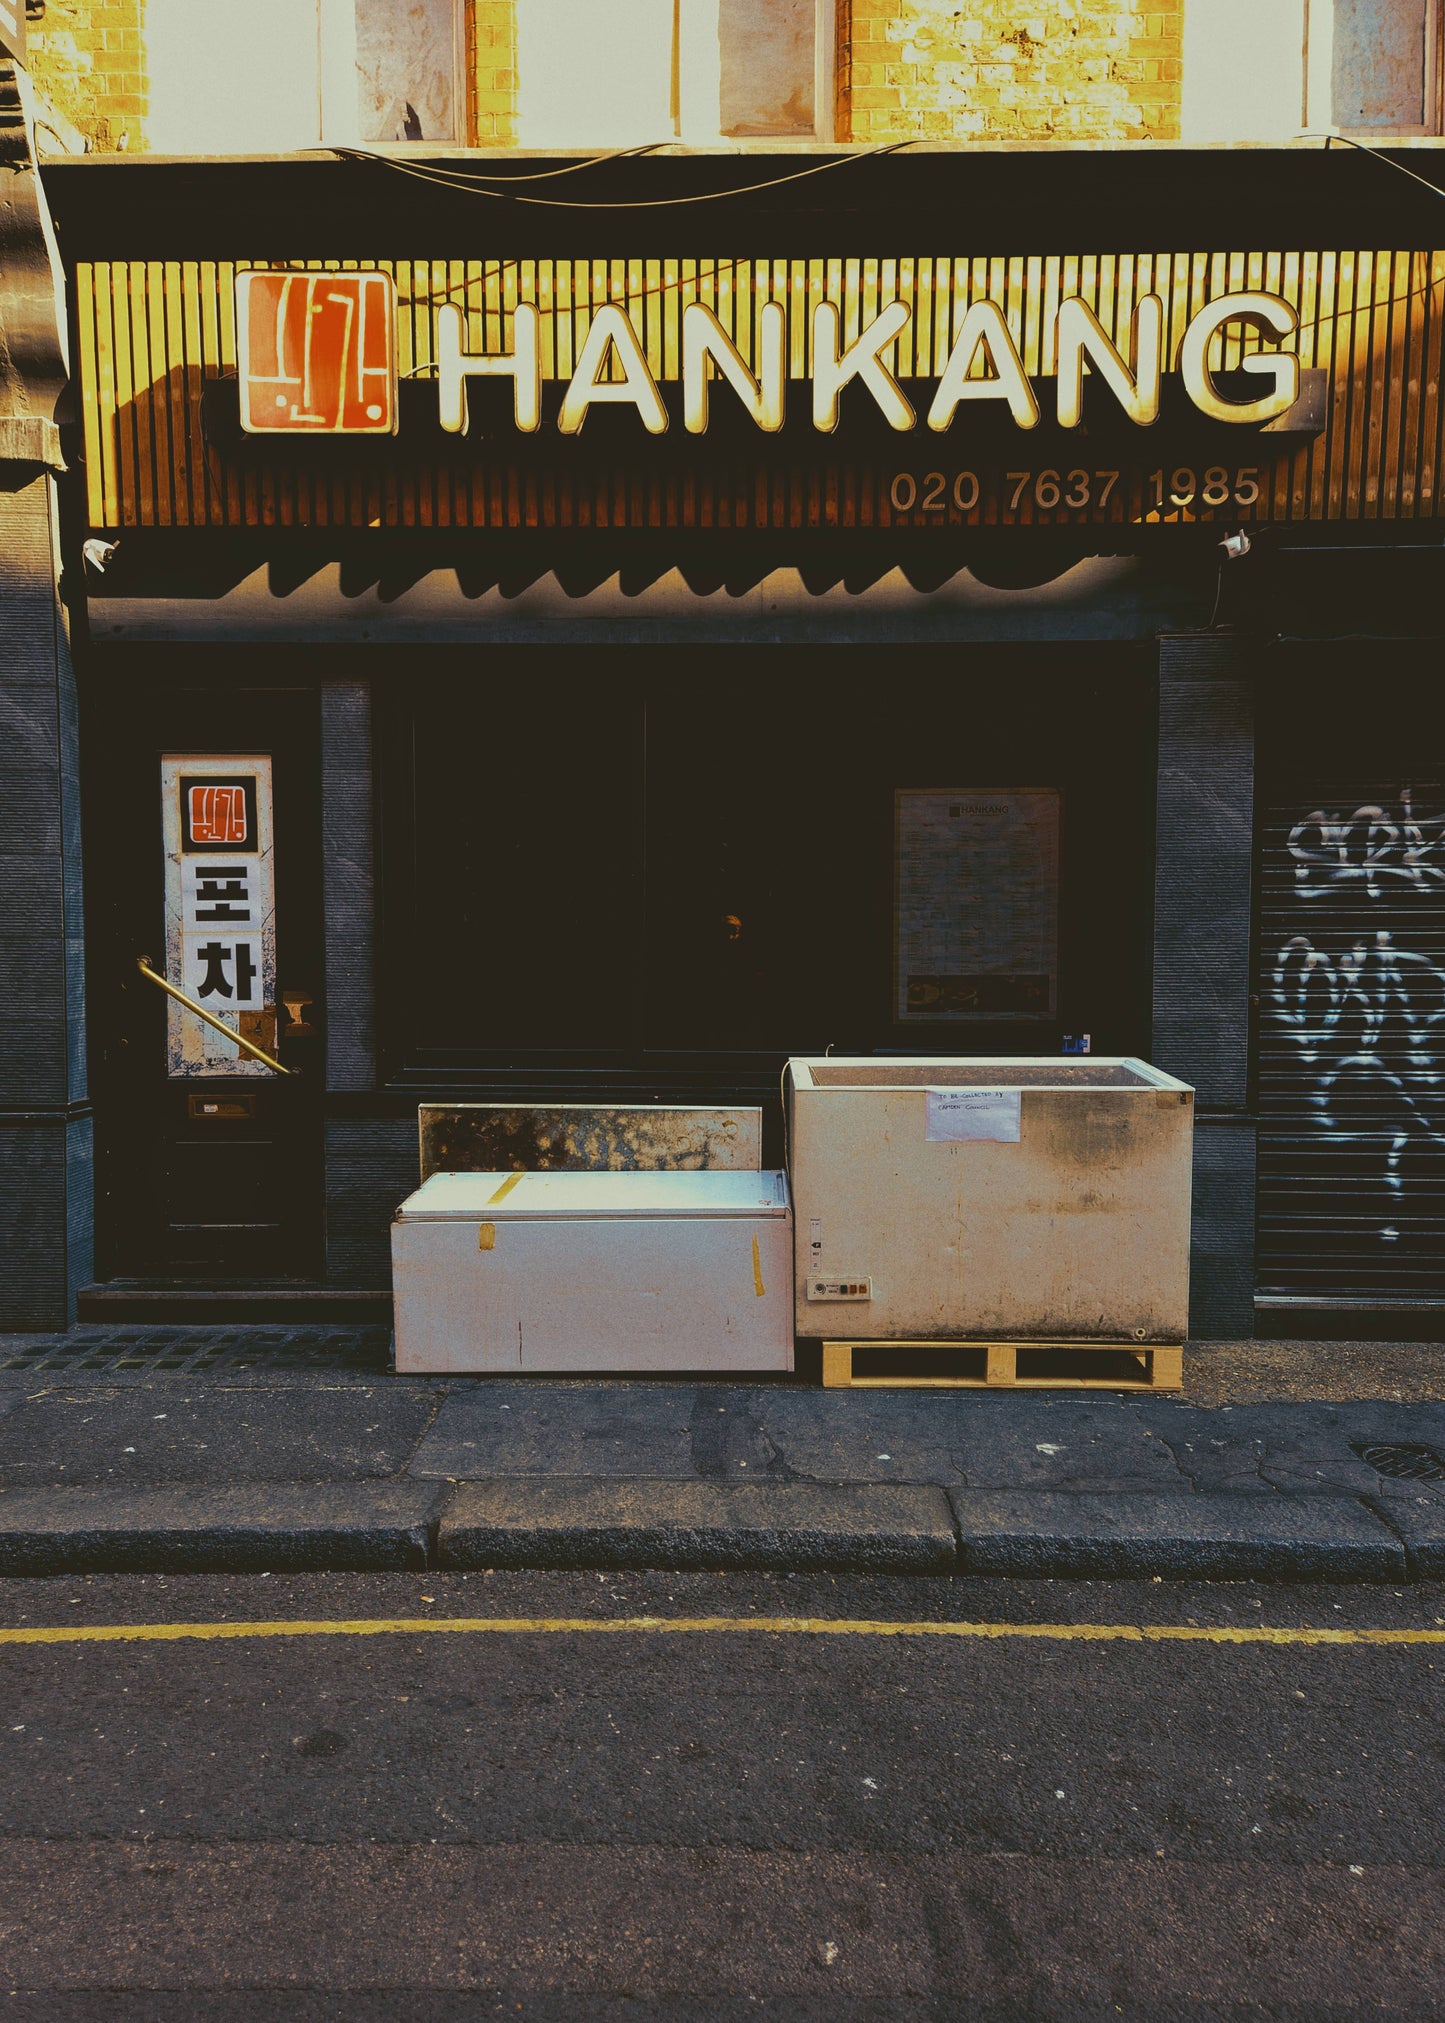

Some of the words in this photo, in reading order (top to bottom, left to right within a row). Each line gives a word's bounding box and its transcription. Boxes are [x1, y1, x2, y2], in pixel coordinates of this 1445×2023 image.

[438, 291, 1300, 435] HANKANG
[890, 472, 980, 511] 020
[1006, 469, 1120, 511] 7637
[1149, 467, 1260, 506] 1985
[960, 804, 1009, 814] HANKANG
[195, 866, 256, 1001] 포차
